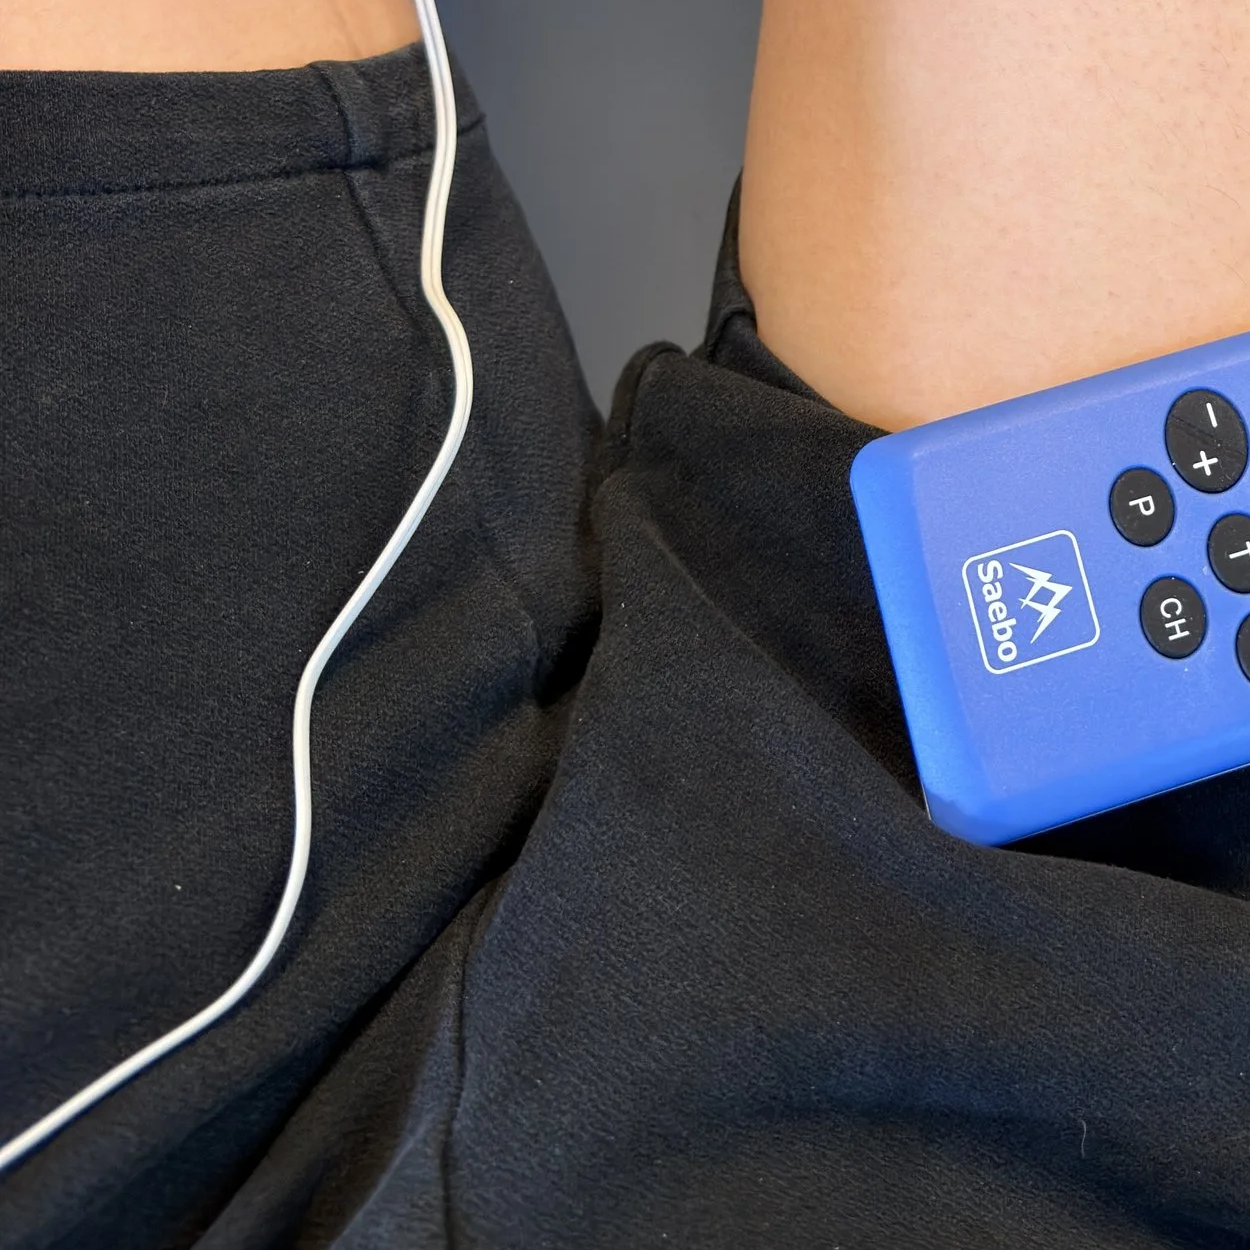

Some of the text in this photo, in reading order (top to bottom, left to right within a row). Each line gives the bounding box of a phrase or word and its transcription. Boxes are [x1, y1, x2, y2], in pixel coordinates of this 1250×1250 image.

[1128, 495, 1155, 516] P
[977, 559, 1018, 662] Saebo
[1159, 597, 1190, 641] CH
